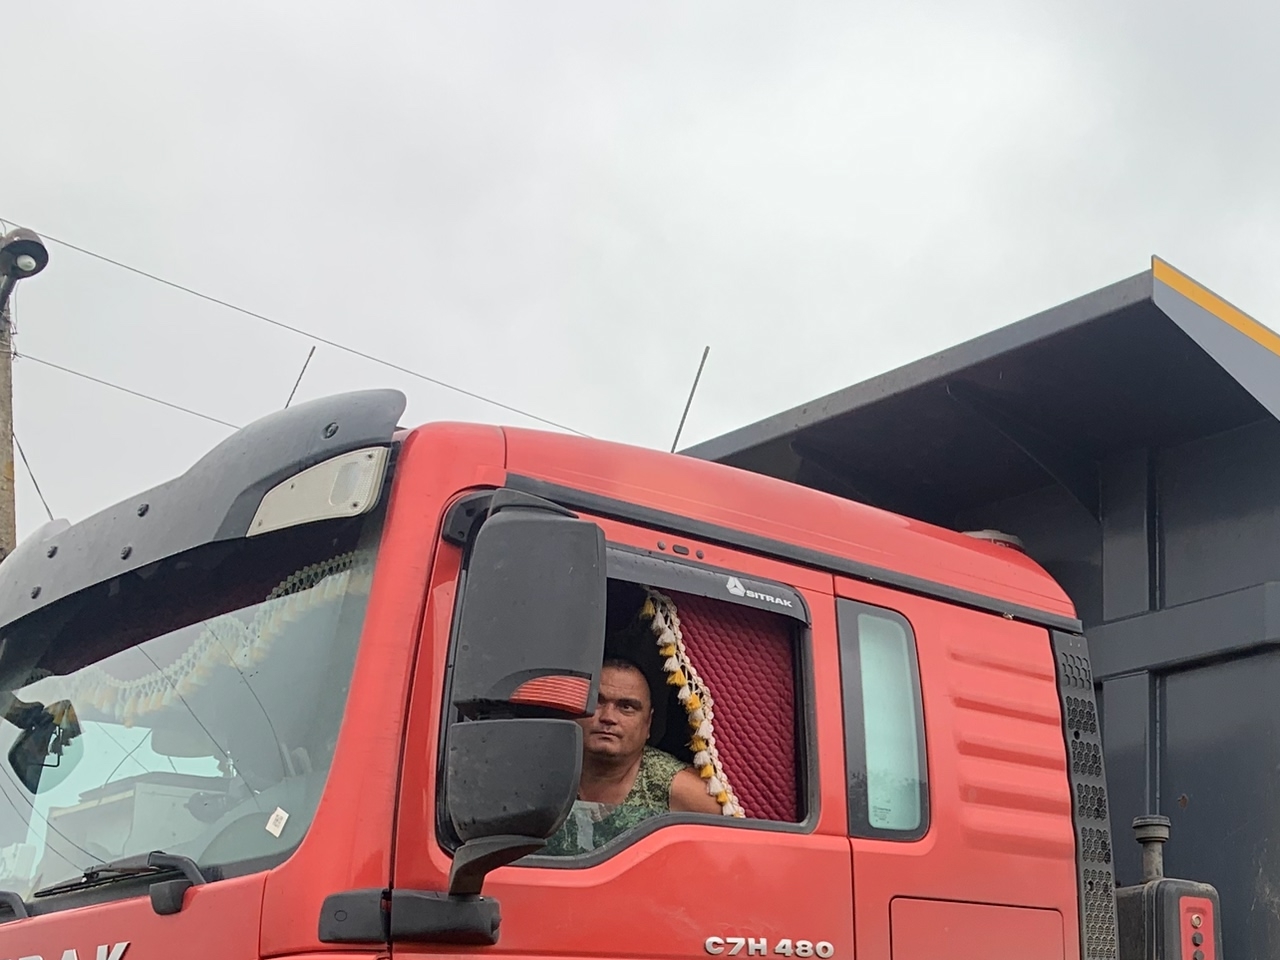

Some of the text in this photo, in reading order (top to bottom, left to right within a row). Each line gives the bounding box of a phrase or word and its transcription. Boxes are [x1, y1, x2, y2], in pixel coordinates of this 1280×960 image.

[746, 590, 792, 607] SITRAK
[705, 936, 834, 958] C7H 480
